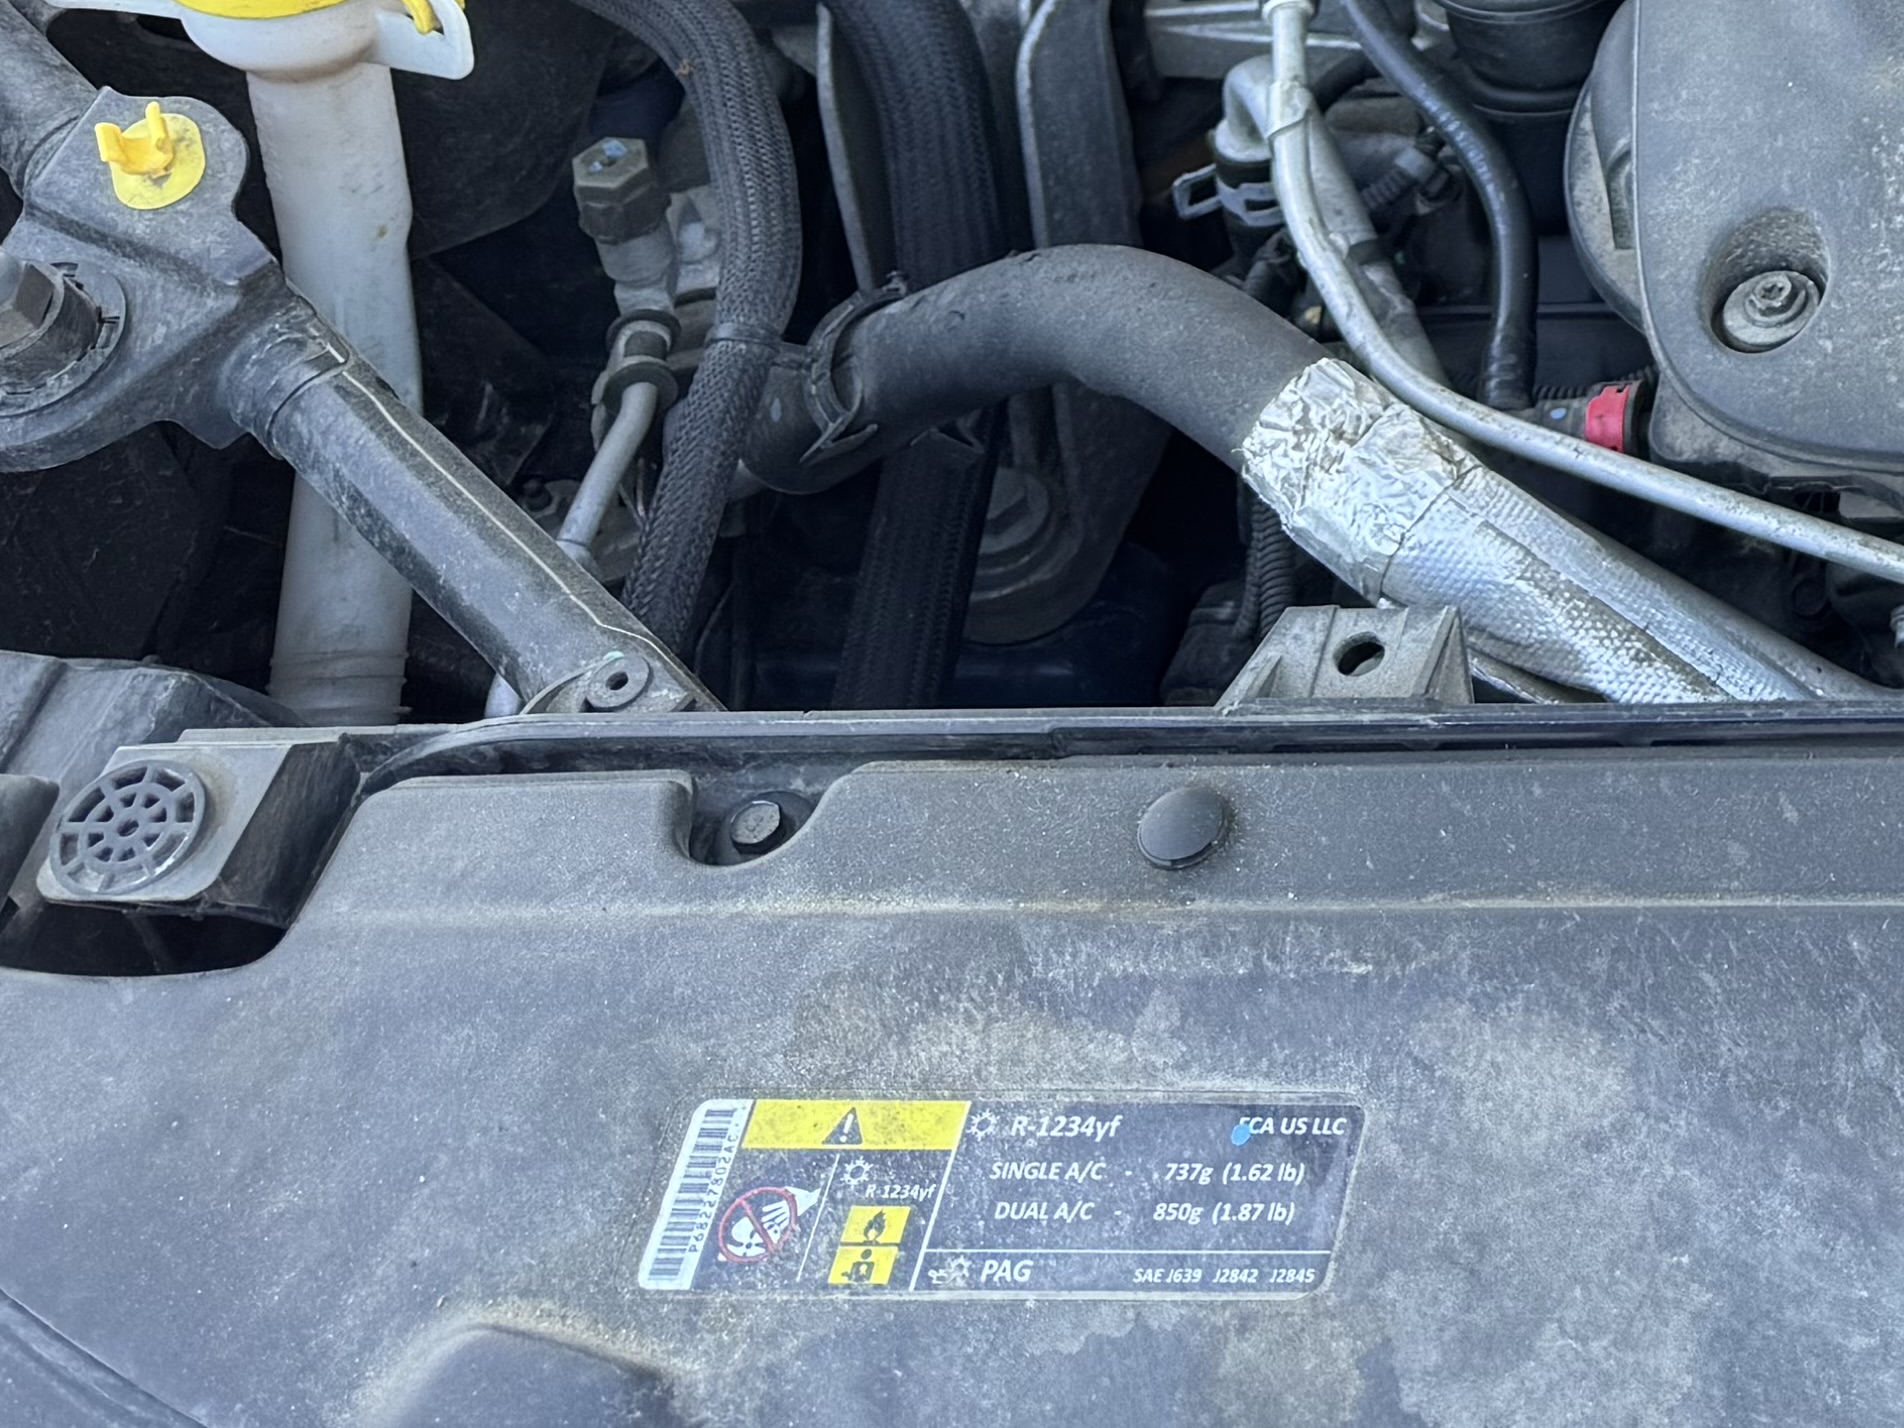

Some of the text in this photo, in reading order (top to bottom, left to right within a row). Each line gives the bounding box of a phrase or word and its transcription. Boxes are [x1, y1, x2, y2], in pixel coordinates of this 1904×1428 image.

[1011, 1115, 1123, 1142] R-1234yf
[1281, 1118, 1307, 1135] US
[1313, 1117, 1347, 1135] LLC
[990, 1161, 1063, 1180] SINGLE
[1065, 1161, 1106, 1183] A/C
[1165, 1163, 1213, 1185] 737g
[1222, 1162, 1273, 1185] (1.62
[1278, 1163, 1305, 1186] lb)
[865, 1183, 936, 1201] R-1234yf
[994, 1201, 1049, 1220] DUAL
[1054, 1201, 1095, 1223] A/C
[1153, 1203, 1203, 1225] 850g
[1212, 1202, 1264, 1225] (1.87
[1268, 1202, 1295, 1225] lb)
[980, 1259, 1033, 1283] PAG
[1133, 1268, 1315, 1283] SAE J639 J2842 J2845
